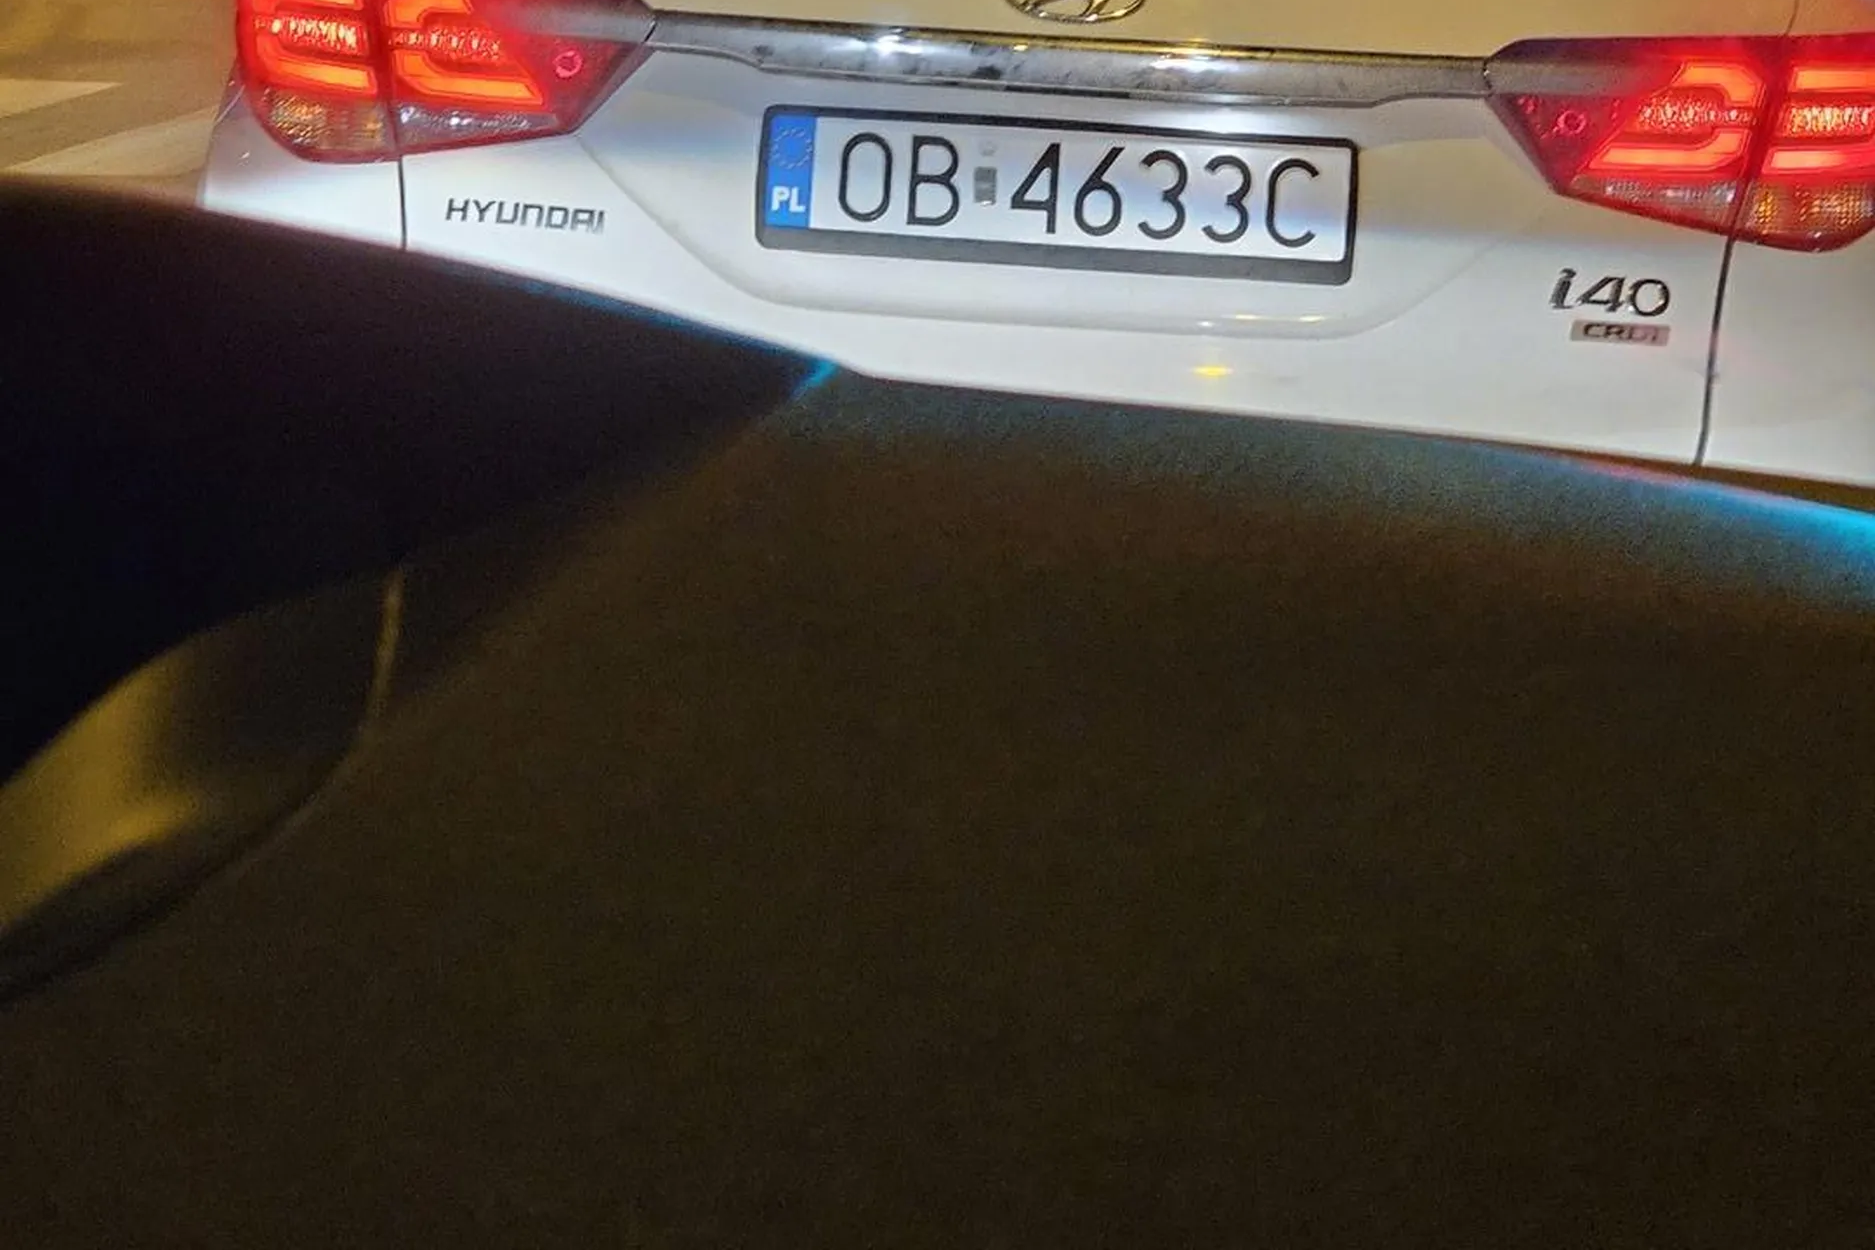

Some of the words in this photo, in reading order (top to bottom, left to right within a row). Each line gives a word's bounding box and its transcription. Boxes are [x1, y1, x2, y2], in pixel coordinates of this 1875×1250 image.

[771, 185, 806, 213] PL
[837, 132, 960, 226] OB
[1009, 141, 1320, 249] 4633C
[445, 198, 605, 234] HYUNDAI
[1549, 268, 1670, 316] i40
